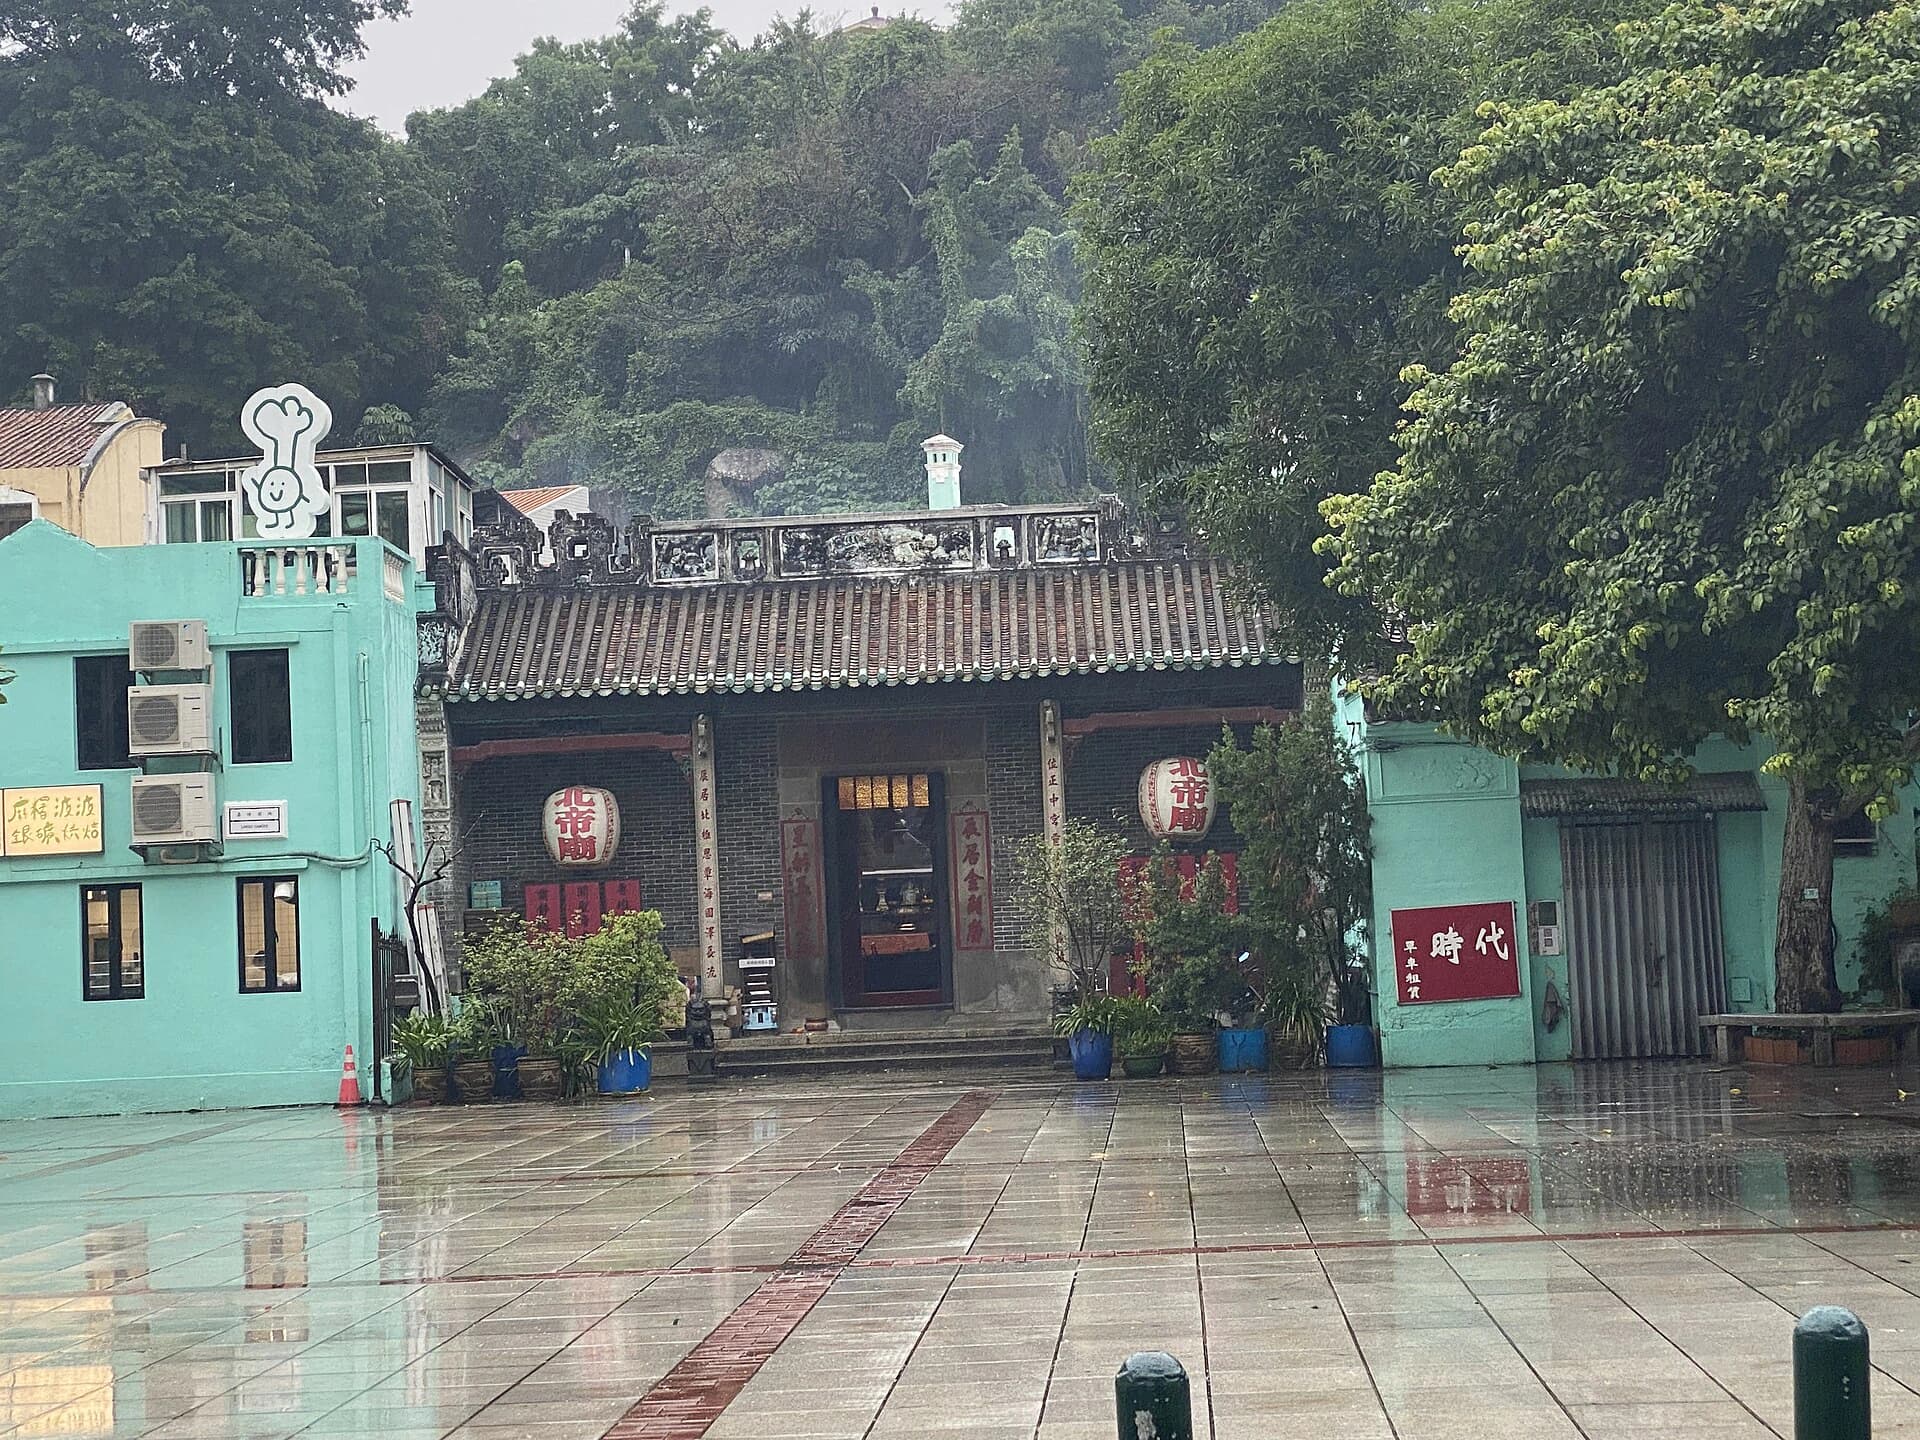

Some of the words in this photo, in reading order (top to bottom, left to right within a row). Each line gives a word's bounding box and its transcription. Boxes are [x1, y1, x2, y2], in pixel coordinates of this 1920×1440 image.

[554, 788, 597, 861] 北帝廟
[1167, 757, 1209, 832] 北帝廟
[1403, 940, 1422, 999] 單車租賃
[1430, 921, 1508, 965] 時代
